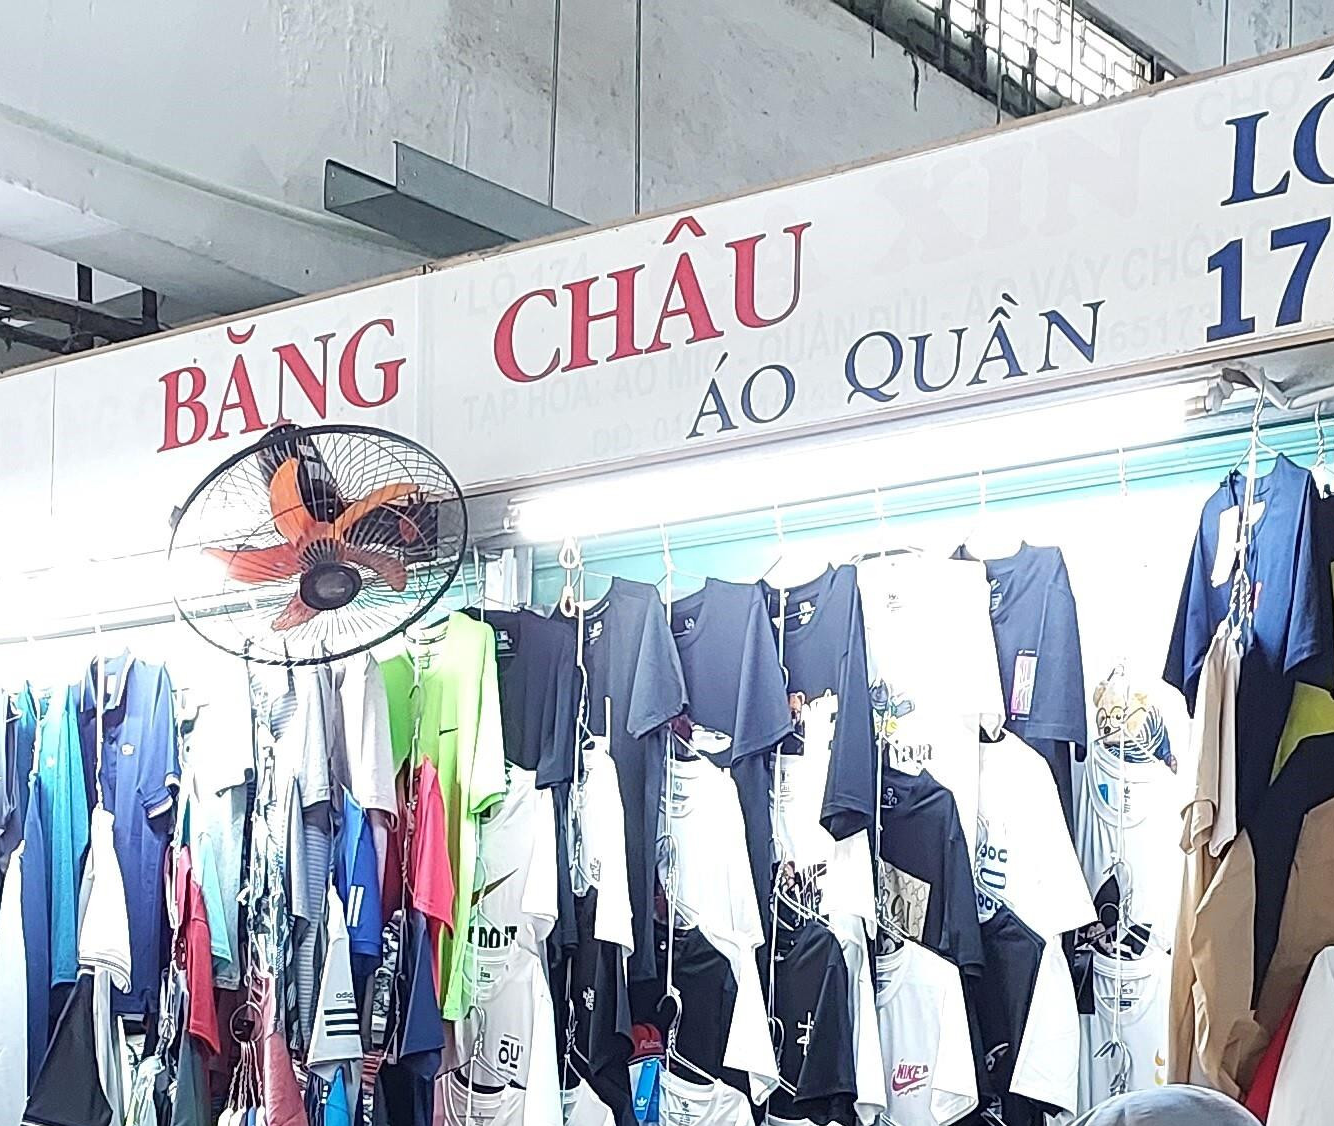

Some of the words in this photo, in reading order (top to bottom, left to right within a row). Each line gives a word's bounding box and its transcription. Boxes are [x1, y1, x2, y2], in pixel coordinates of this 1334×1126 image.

[157, 319, 406, 453] BĂNG
[493, 217, 812, 387] CHÂU
[686, 352, 797, 440] ÁO
[844, 292, 1106, 404] QUẦN
